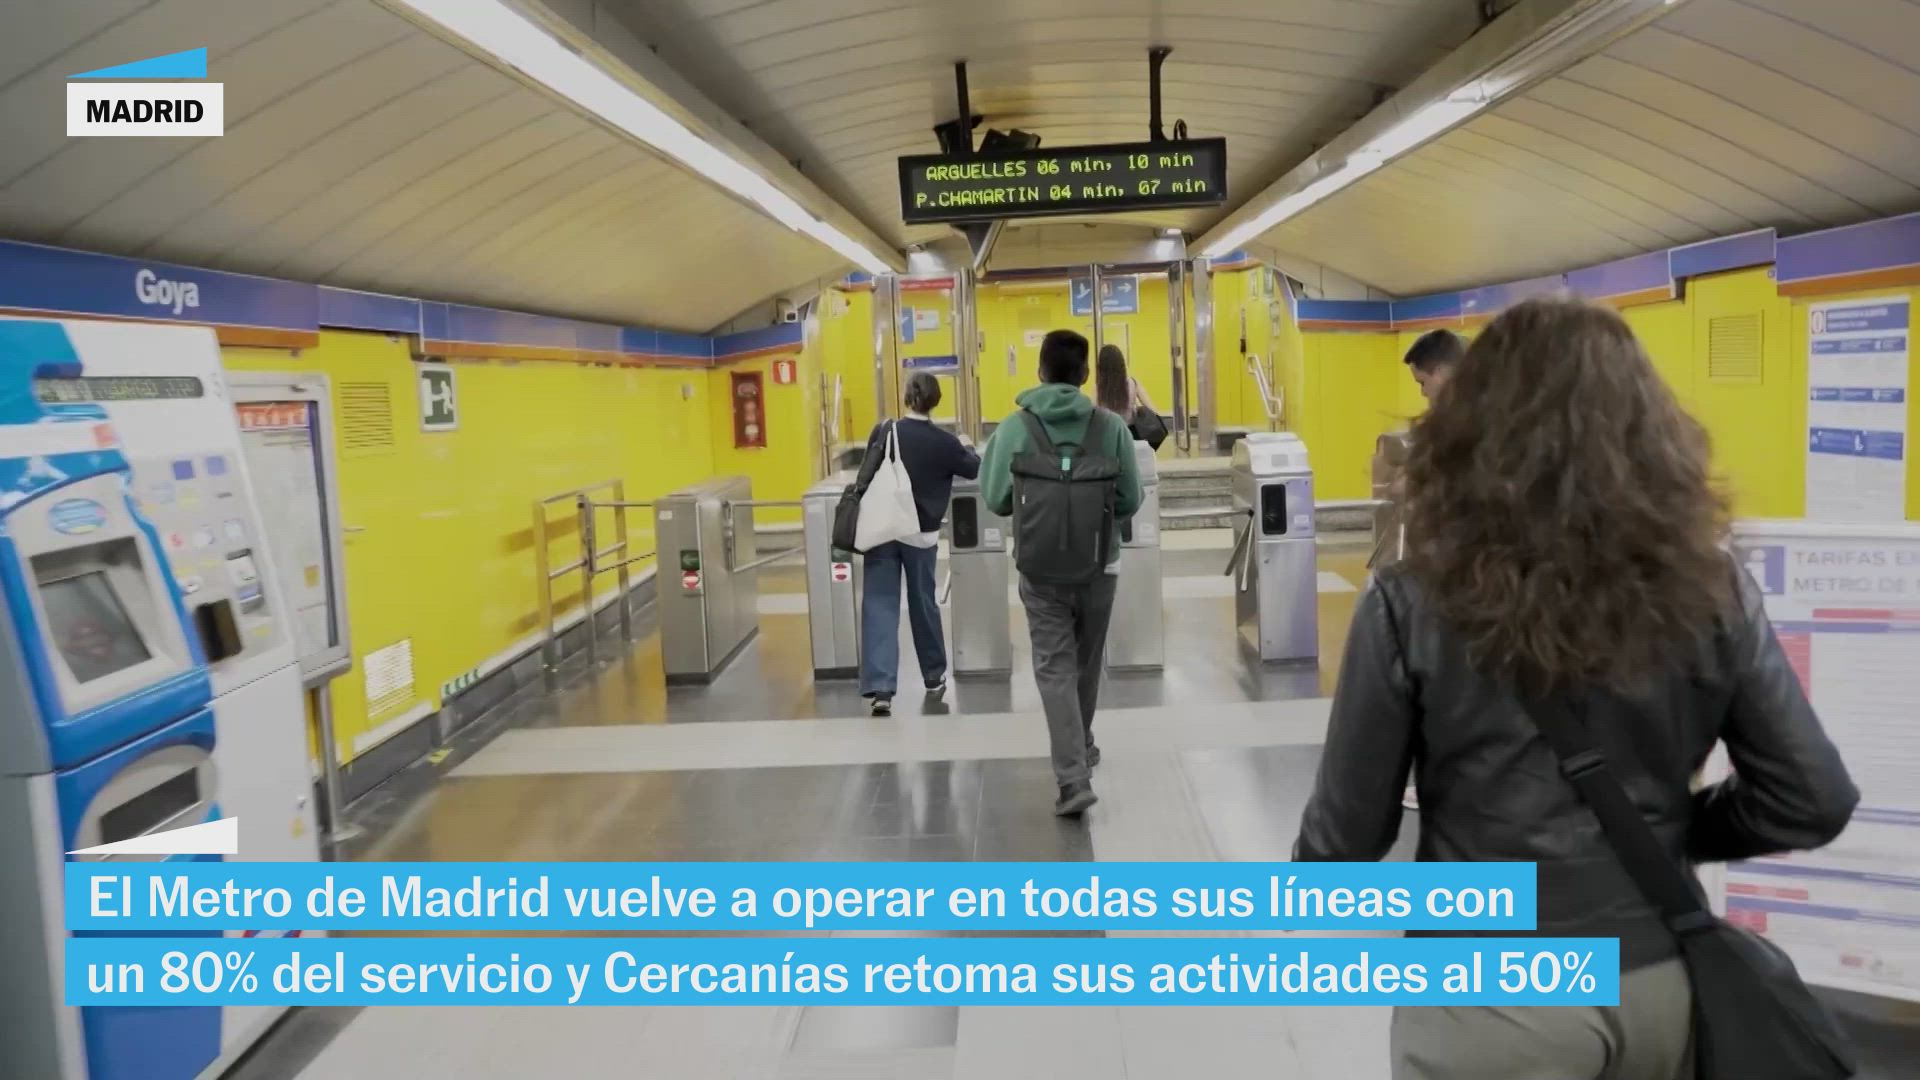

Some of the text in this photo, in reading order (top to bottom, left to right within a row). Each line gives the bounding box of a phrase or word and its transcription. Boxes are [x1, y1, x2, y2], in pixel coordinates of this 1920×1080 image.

[925, 152, 1194, 181] ARGUELLES 06 min, 10 min
[916, 178, 1206, 208] P.CHAMARTIN 04 min, 07 min
[135, 268, 200, 315] Goya
[1793, 551, 1887, 566] TARIFAS
[1793, 577, 1872, 592] METRO
